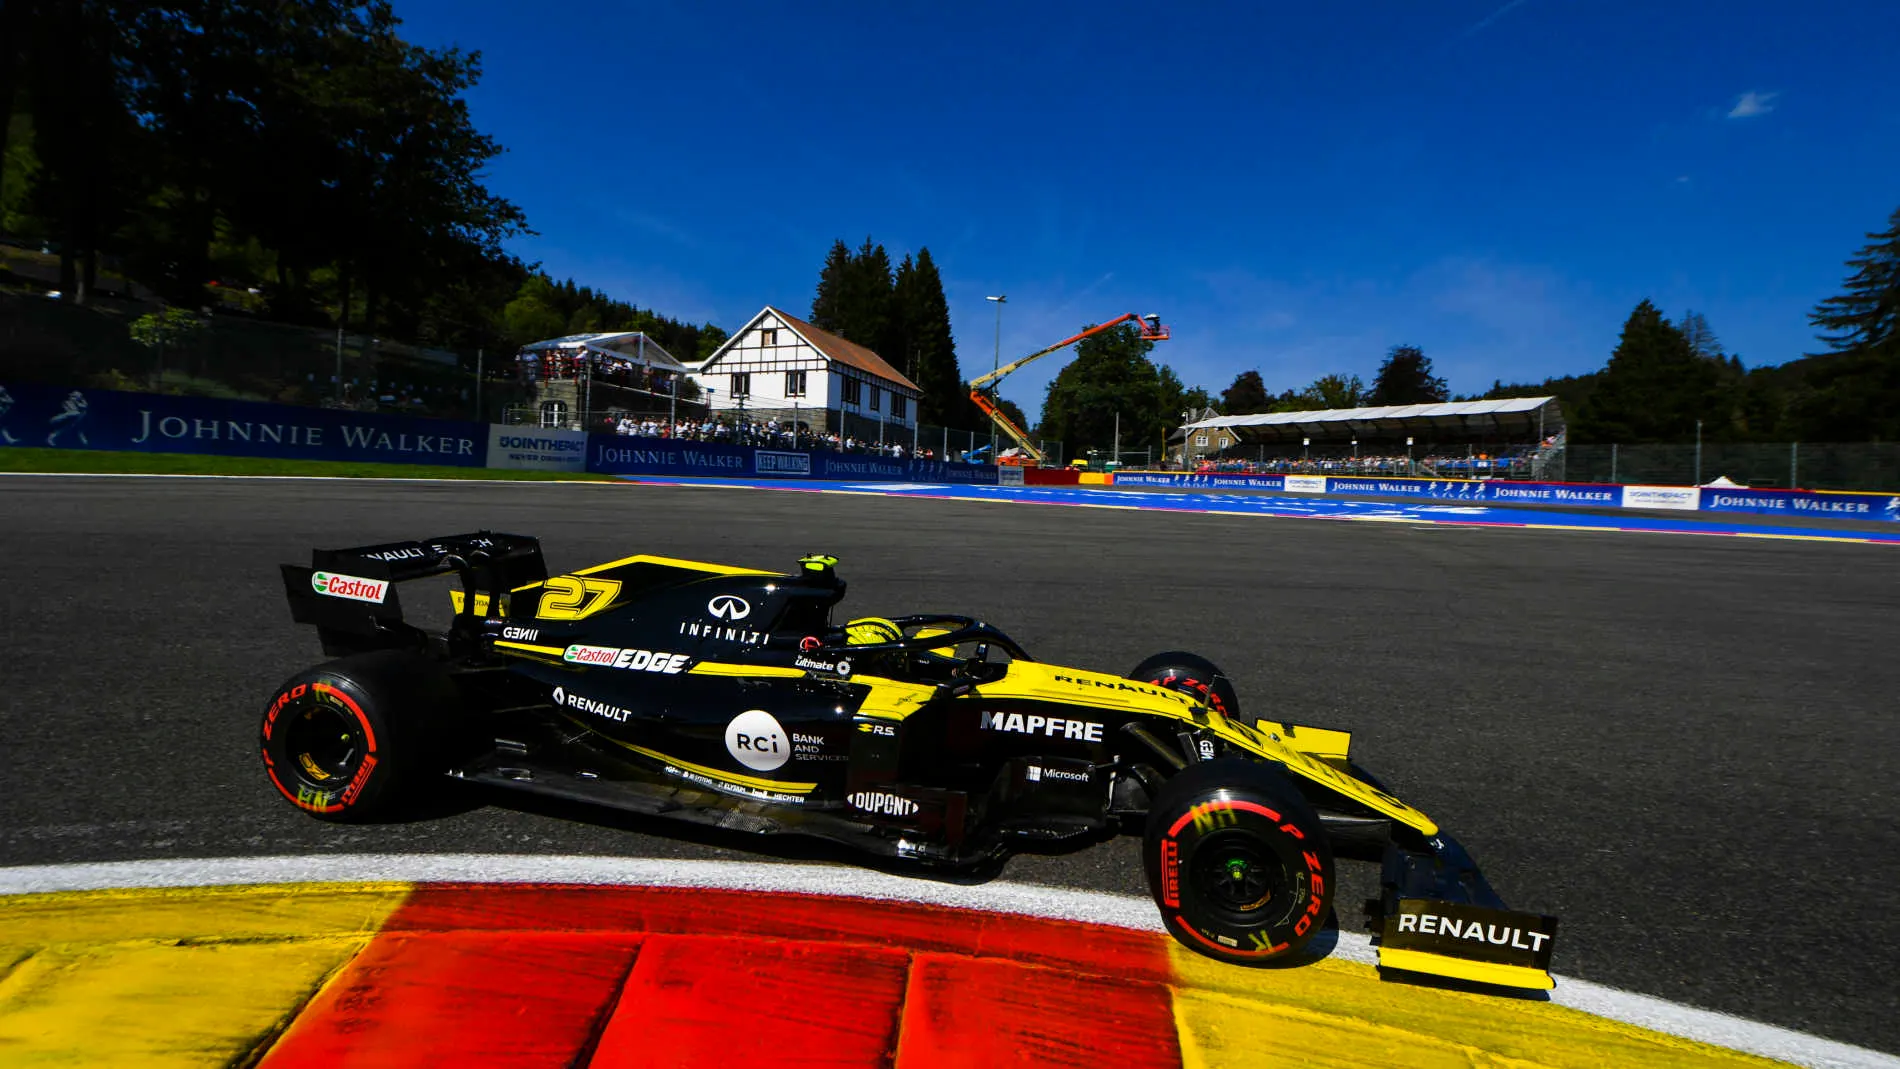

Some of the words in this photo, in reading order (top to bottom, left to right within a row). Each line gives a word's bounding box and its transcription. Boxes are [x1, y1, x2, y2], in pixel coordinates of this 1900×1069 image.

[132, 410, 323, 446] JOHNNIE
[341, 425, 475, 456] WALKER
[596, 444, 677, 466] JOHNNIE
[683, 450, 743, 469] WALKER
[757, 454, 776, 470] KEEP
[777, 455, 809, 472] WALKING
[824, 460, 867, 475] JOHNNIE
[869, 462, 903, 476] WALKER
[1116, 474, 1144, 484] JOHNNIE
[1146, 475, 1171, 485] WALKER
[1213, 477, 1247, 487] JOHNNIE
[1248, 478, 1282, 488] WALKER
[1332, 481, 1375, 492] JOHNNIE
[1378, 482, 1421, 494] WALKER
[1493, 486, 1550, 500] JOHNNIE
[1554, 488, 1612, 502] WALKER
[1709, 493, 1785, 510] JOHNNIE
[1792, 497, 1870, 514] WALKER
[327, 576, 383, 600] Castrol
[535, 574, 623, 621] 27
[679, 621, 770, 646] INFINITI
[576, 647, 617, 664] Castrol
[612, 648, 691, 675] EDGE
[262, 683, 308, 741] ZERO
[567, 694, 632, 723] RENAULT
[980, 710, 1104, 742] MAPFRE
[792, 732, 825, 746] BANK
[794, 743, 820, 754] AND
[1043, 767, 1090, 783] Microsoft
[774, 792, 806, 804] HECHTER
[855, 791, 913, 816] DUPONT
[1160, 838, 1181, 909] PIRELLI
[1280, 823, 1306, 840] P
[1293, 850, 1325, 938] ZERO
[1397, 912, 1551, 953] RENAULT
